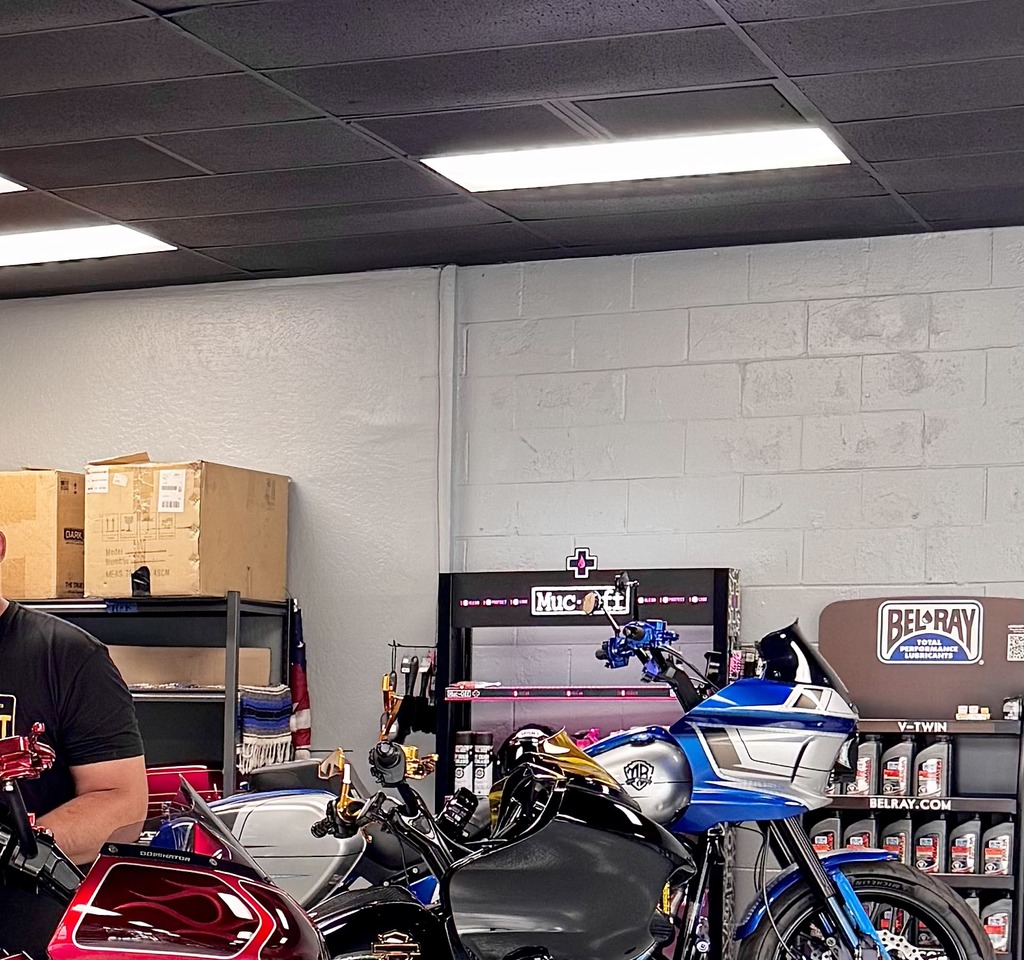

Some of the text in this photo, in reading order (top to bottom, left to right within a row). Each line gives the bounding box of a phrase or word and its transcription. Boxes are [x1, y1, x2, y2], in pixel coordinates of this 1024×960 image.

[905, 652, 953, 660] LUBRICANTS
[898, 722, 947, 733] V-TWIN
[870, 799, 952, 811] BELRAY.COM
[139, 850, 191, 862] DOMINATOR
